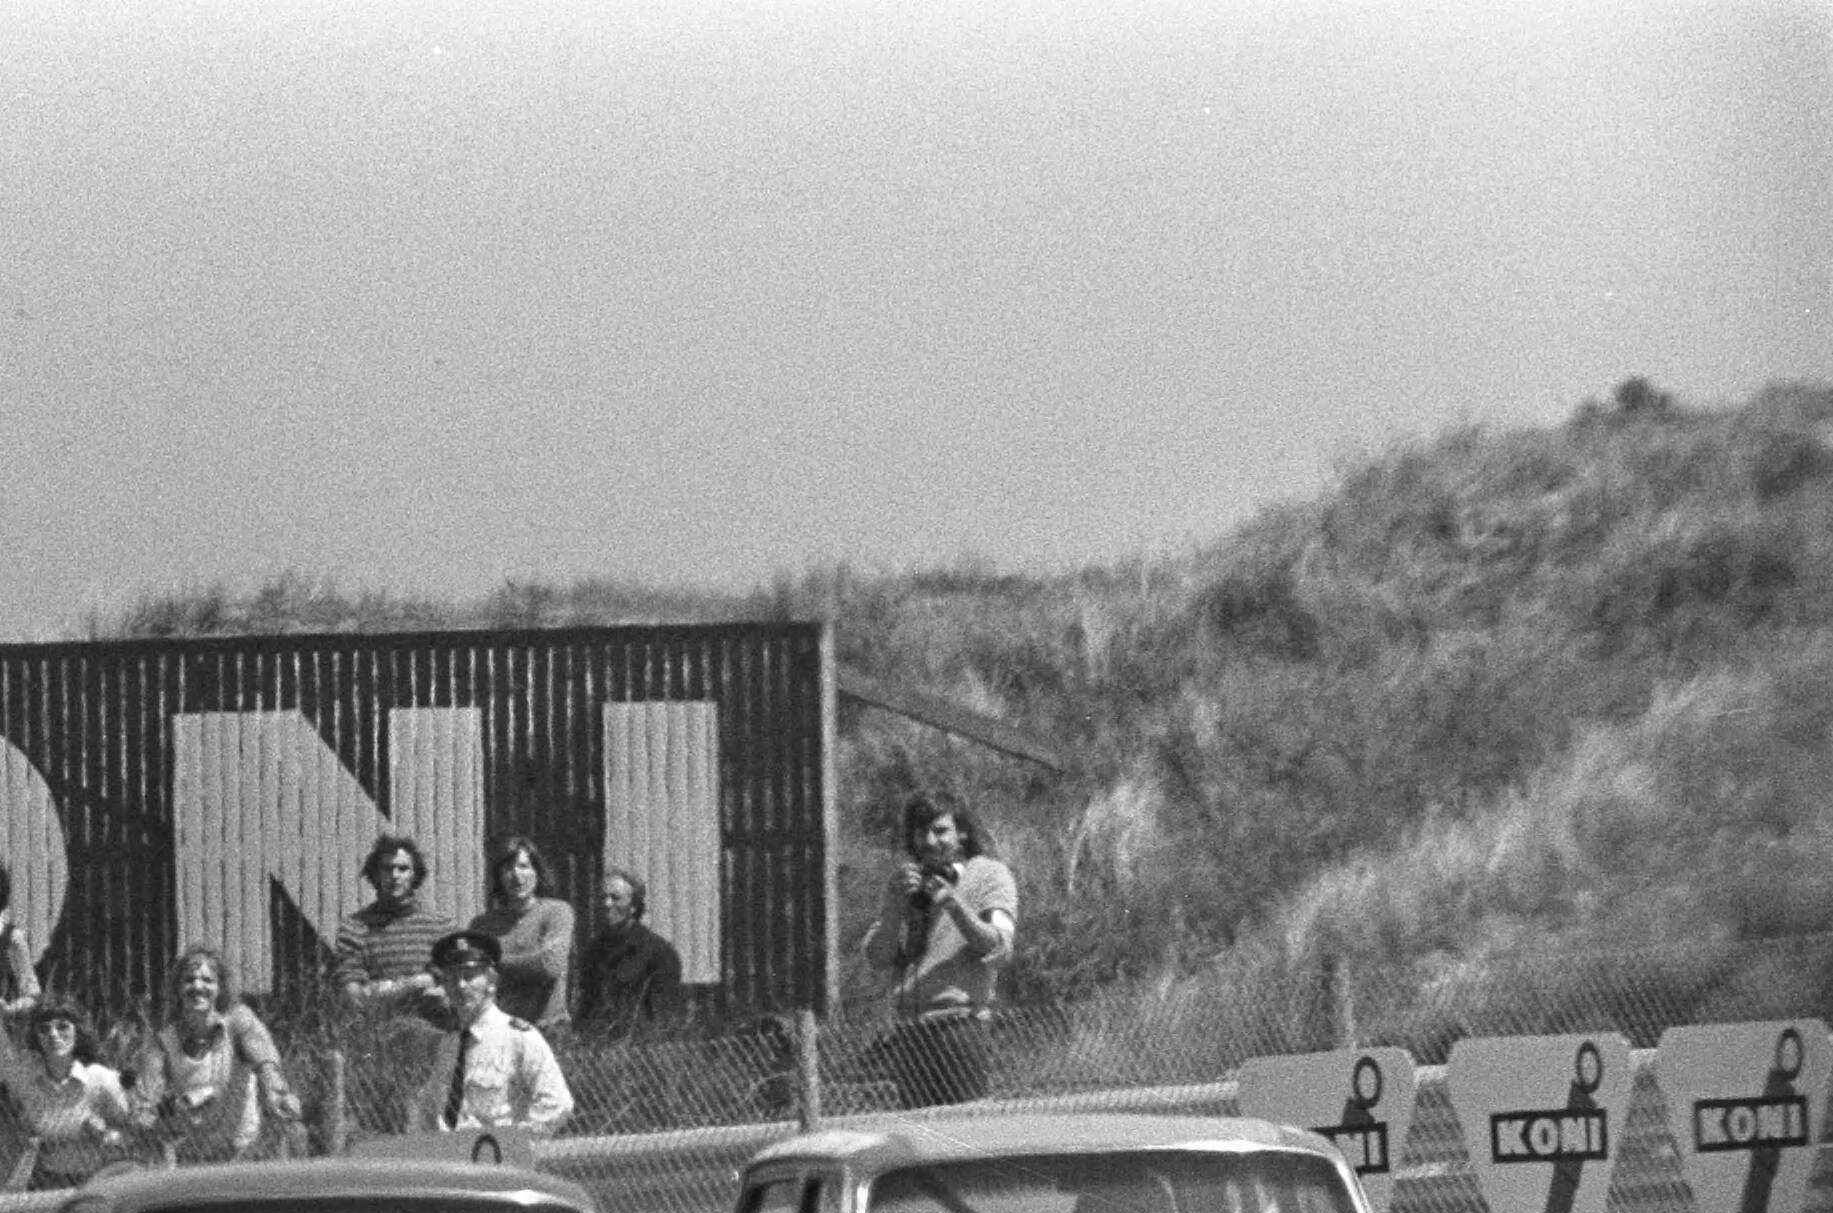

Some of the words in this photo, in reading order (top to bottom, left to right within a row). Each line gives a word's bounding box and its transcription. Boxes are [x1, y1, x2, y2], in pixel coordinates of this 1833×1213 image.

[1495, 1113, 1603, 1158] KONI
[1700, 1101, 1803, 1146] KONI
[1333, 1131, 1382, 1167] NI
